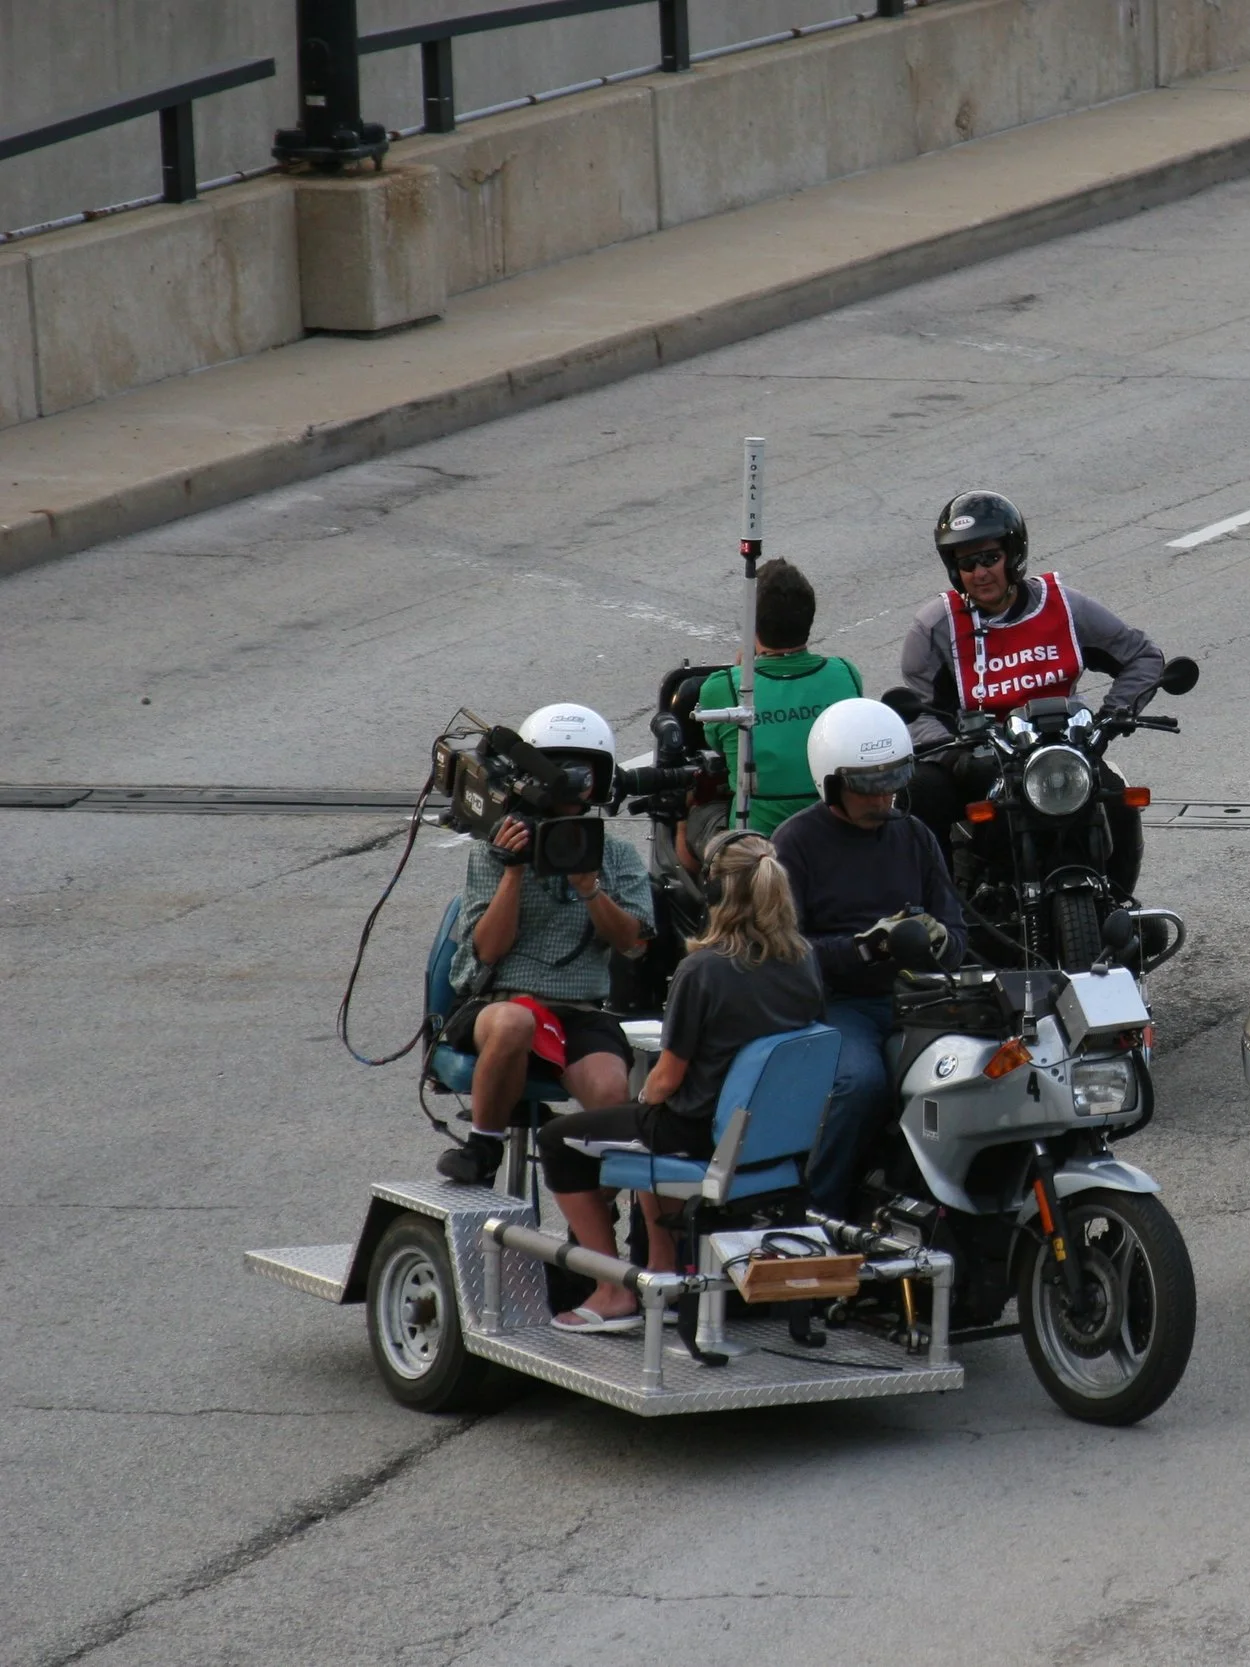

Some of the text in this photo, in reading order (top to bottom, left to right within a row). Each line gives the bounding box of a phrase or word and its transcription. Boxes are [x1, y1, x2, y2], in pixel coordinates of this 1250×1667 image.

[749, 455, 757, 529] TOTAL RF
[971, 669, 1068, 699] OFFICIAL
[860, 737, 893, 752] HJC
[1026, 1071, 1040, 1102] 4
